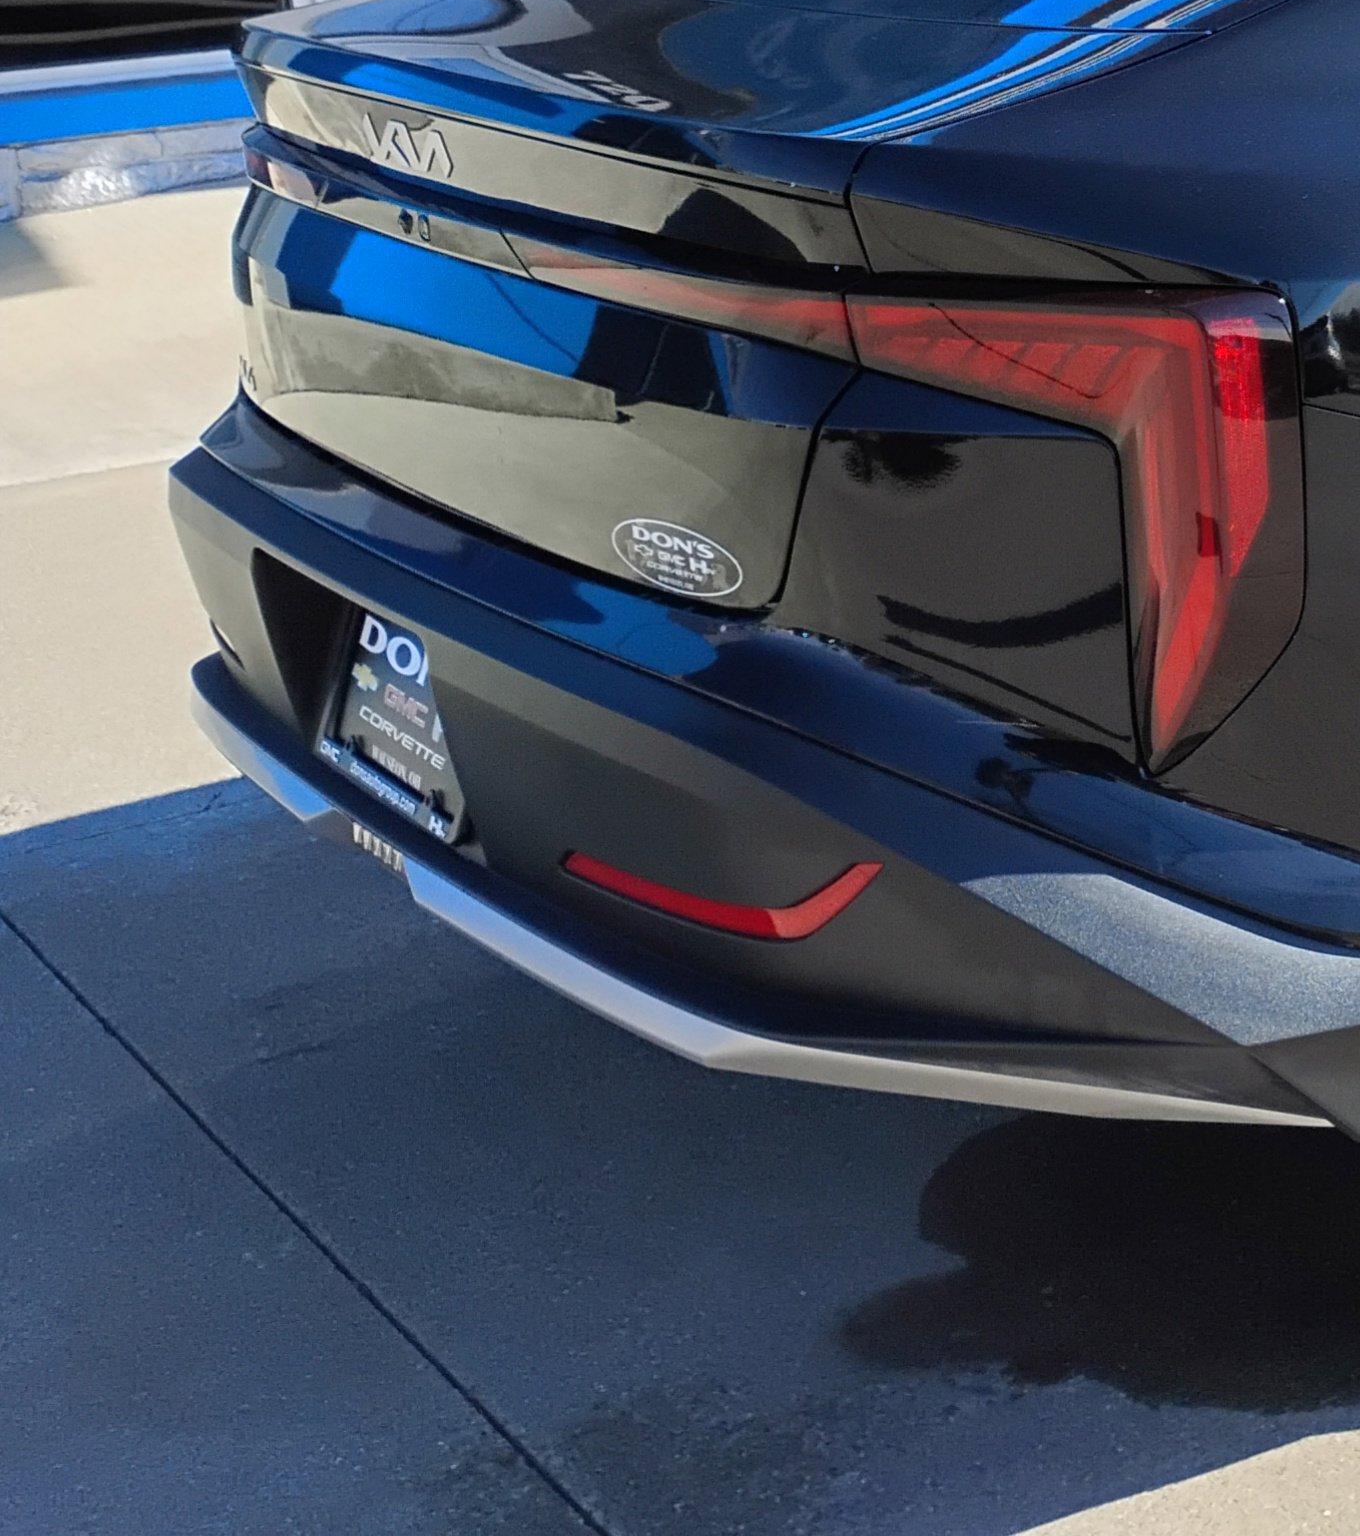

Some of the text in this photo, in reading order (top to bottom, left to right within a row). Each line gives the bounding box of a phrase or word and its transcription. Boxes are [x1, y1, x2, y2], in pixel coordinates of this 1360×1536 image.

[362, 111, 454, 178] KIA
[631, 524, 715, 560] DON'S
[359, 613, 429, 687] DO
[359, 705, 446, 770] CORVETTE
[384, 682, 429, 729] GMC
